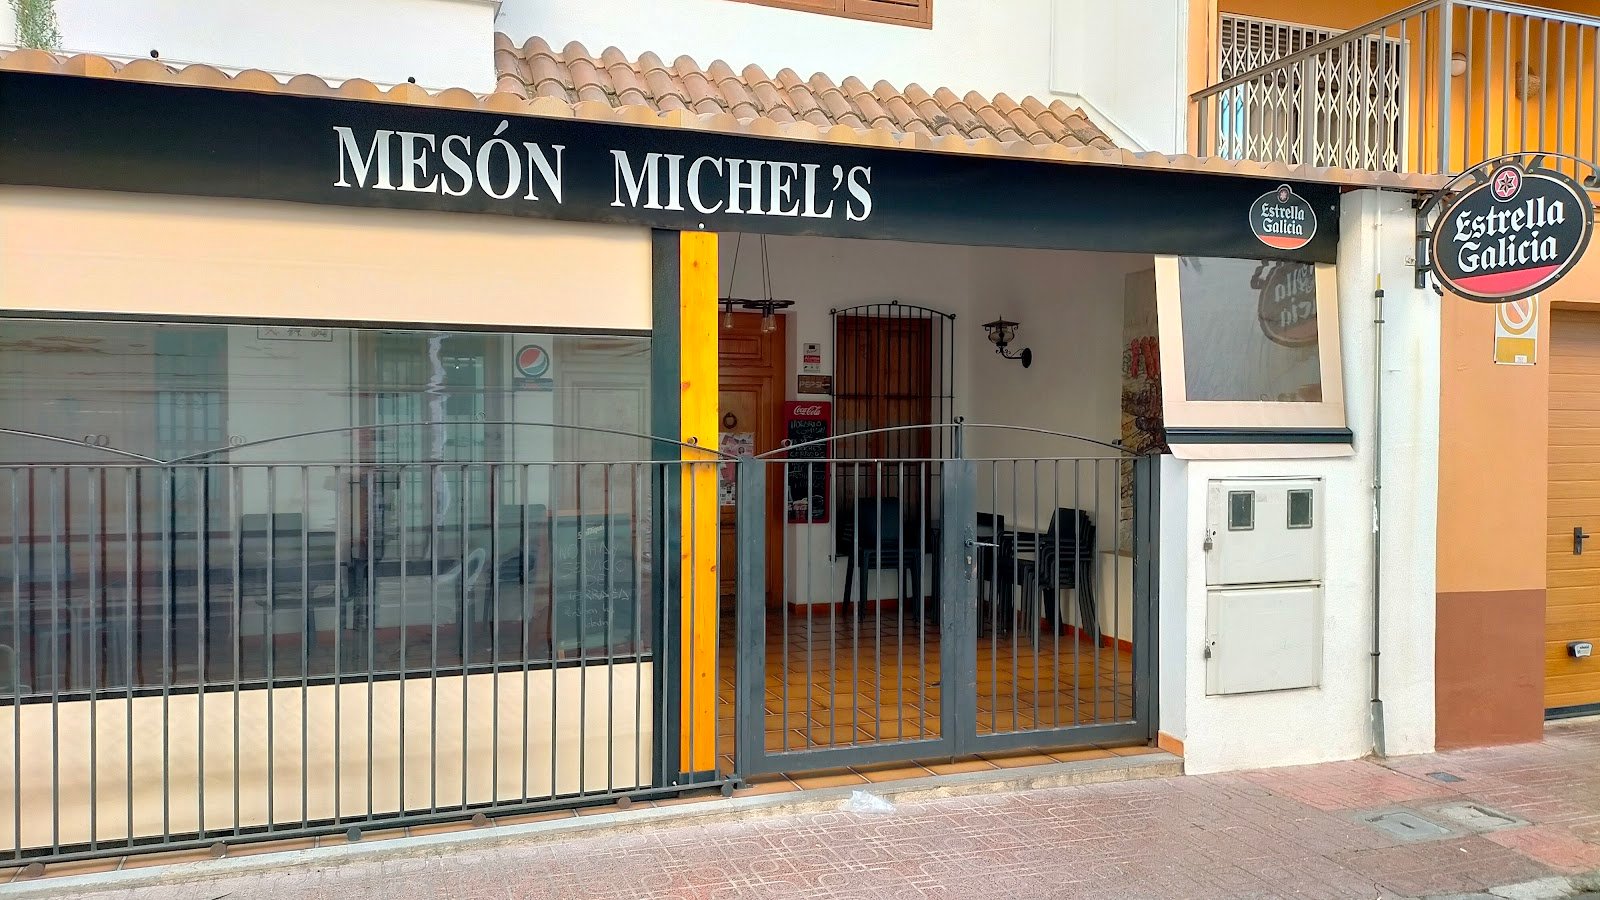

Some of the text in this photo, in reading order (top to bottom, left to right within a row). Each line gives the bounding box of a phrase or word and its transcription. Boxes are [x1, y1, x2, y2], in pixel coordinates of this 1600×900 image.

[333, 119, 872, 222] MESÓN MICHEL'S
[1261, 203, 1305, 221] Estrella
[1263, 218, 1303, 235] Galicia
[1453, 196, 1565, 242] Estrella
[1458, 231, 1558, 273] Galicia
